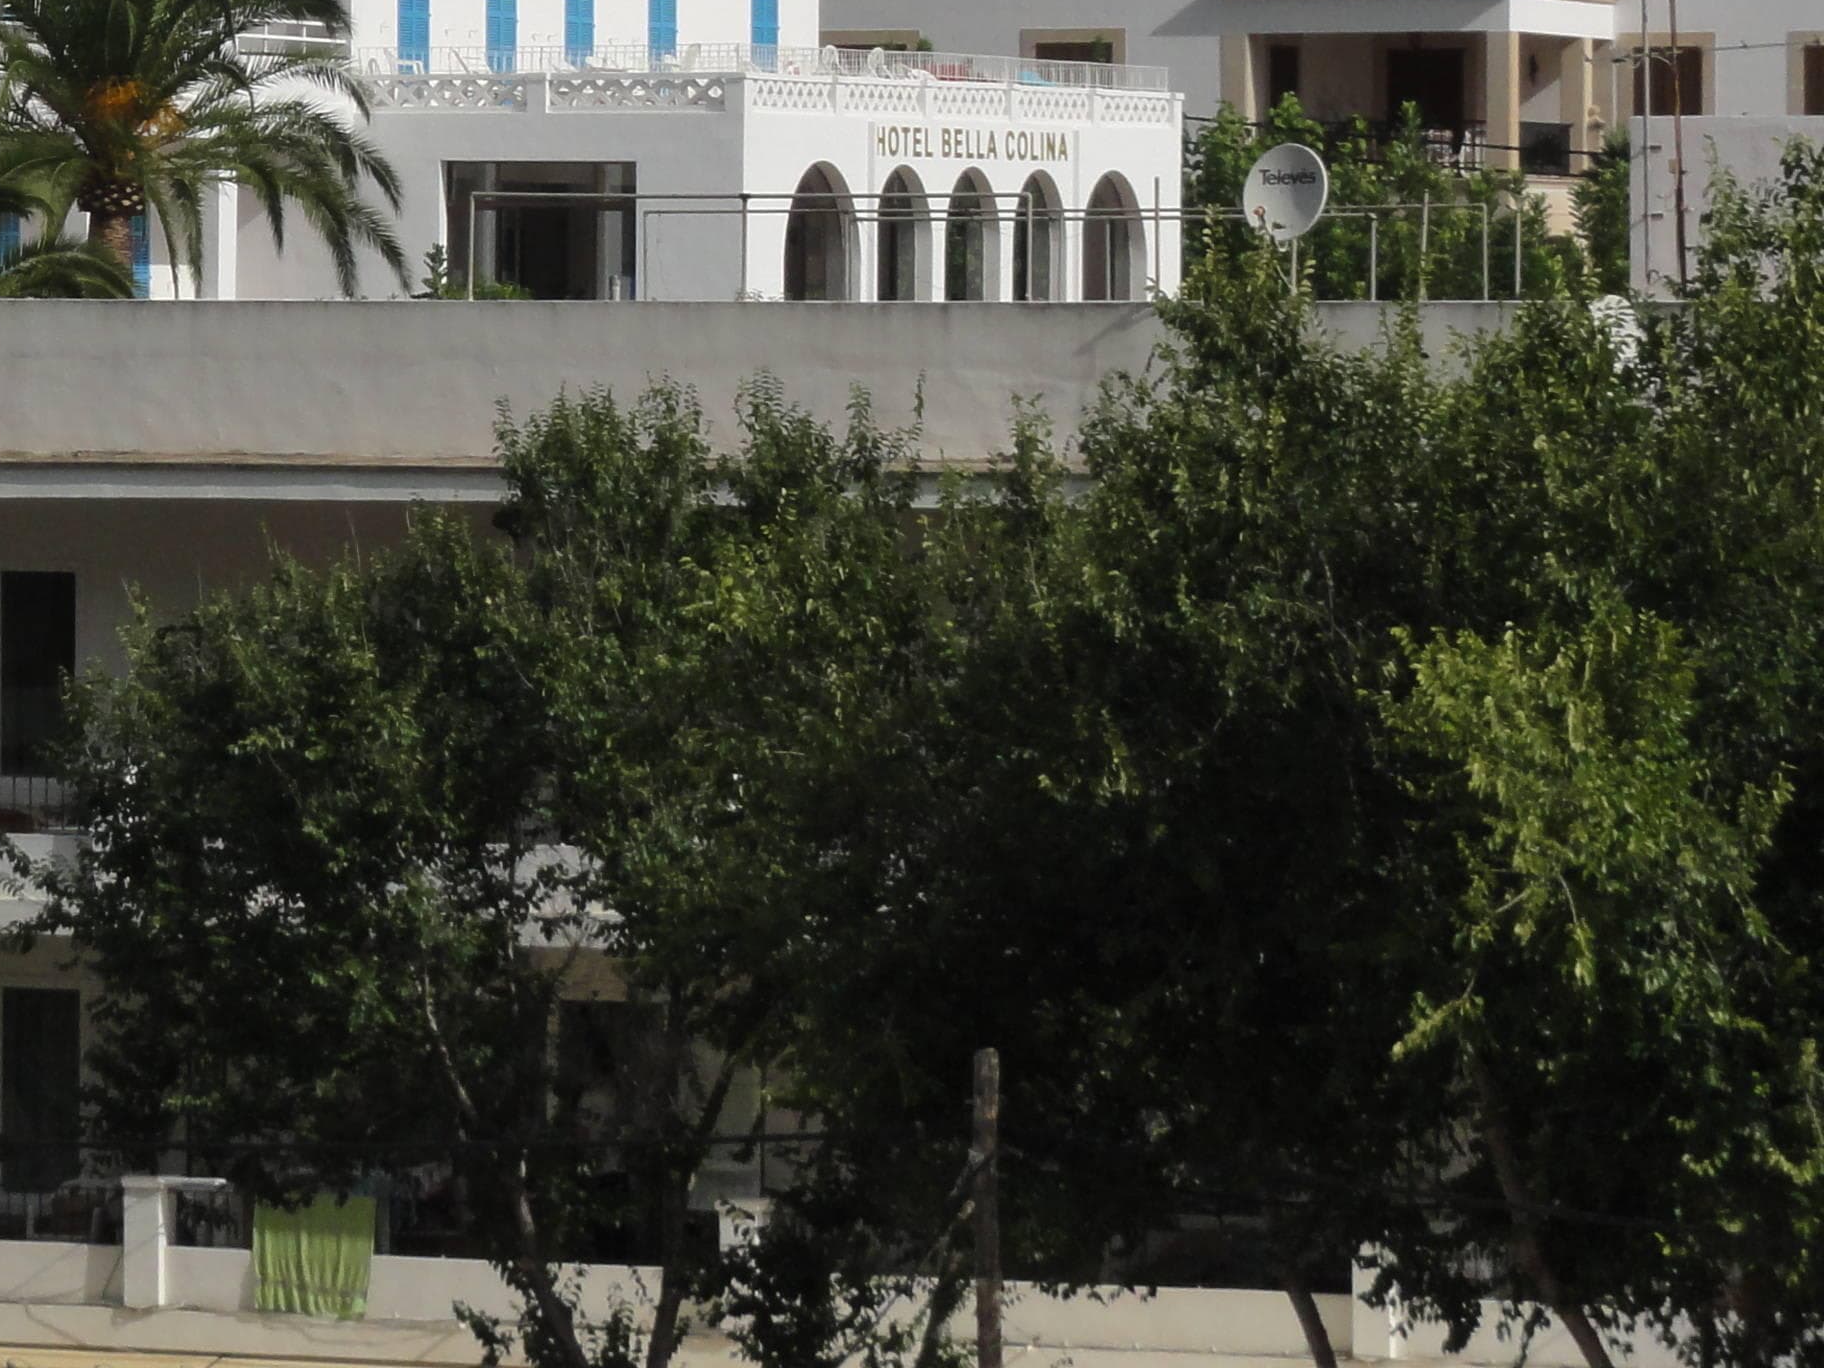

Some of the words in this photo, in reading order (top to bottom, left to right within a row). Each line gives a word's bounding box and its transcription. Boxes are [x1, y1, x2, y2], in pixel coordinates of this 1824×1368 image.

[877, 126, 933, 157] HOTEL
[941, 128, 997, 159] BELLA
[1005, 130, 1068, 161] COLINA
